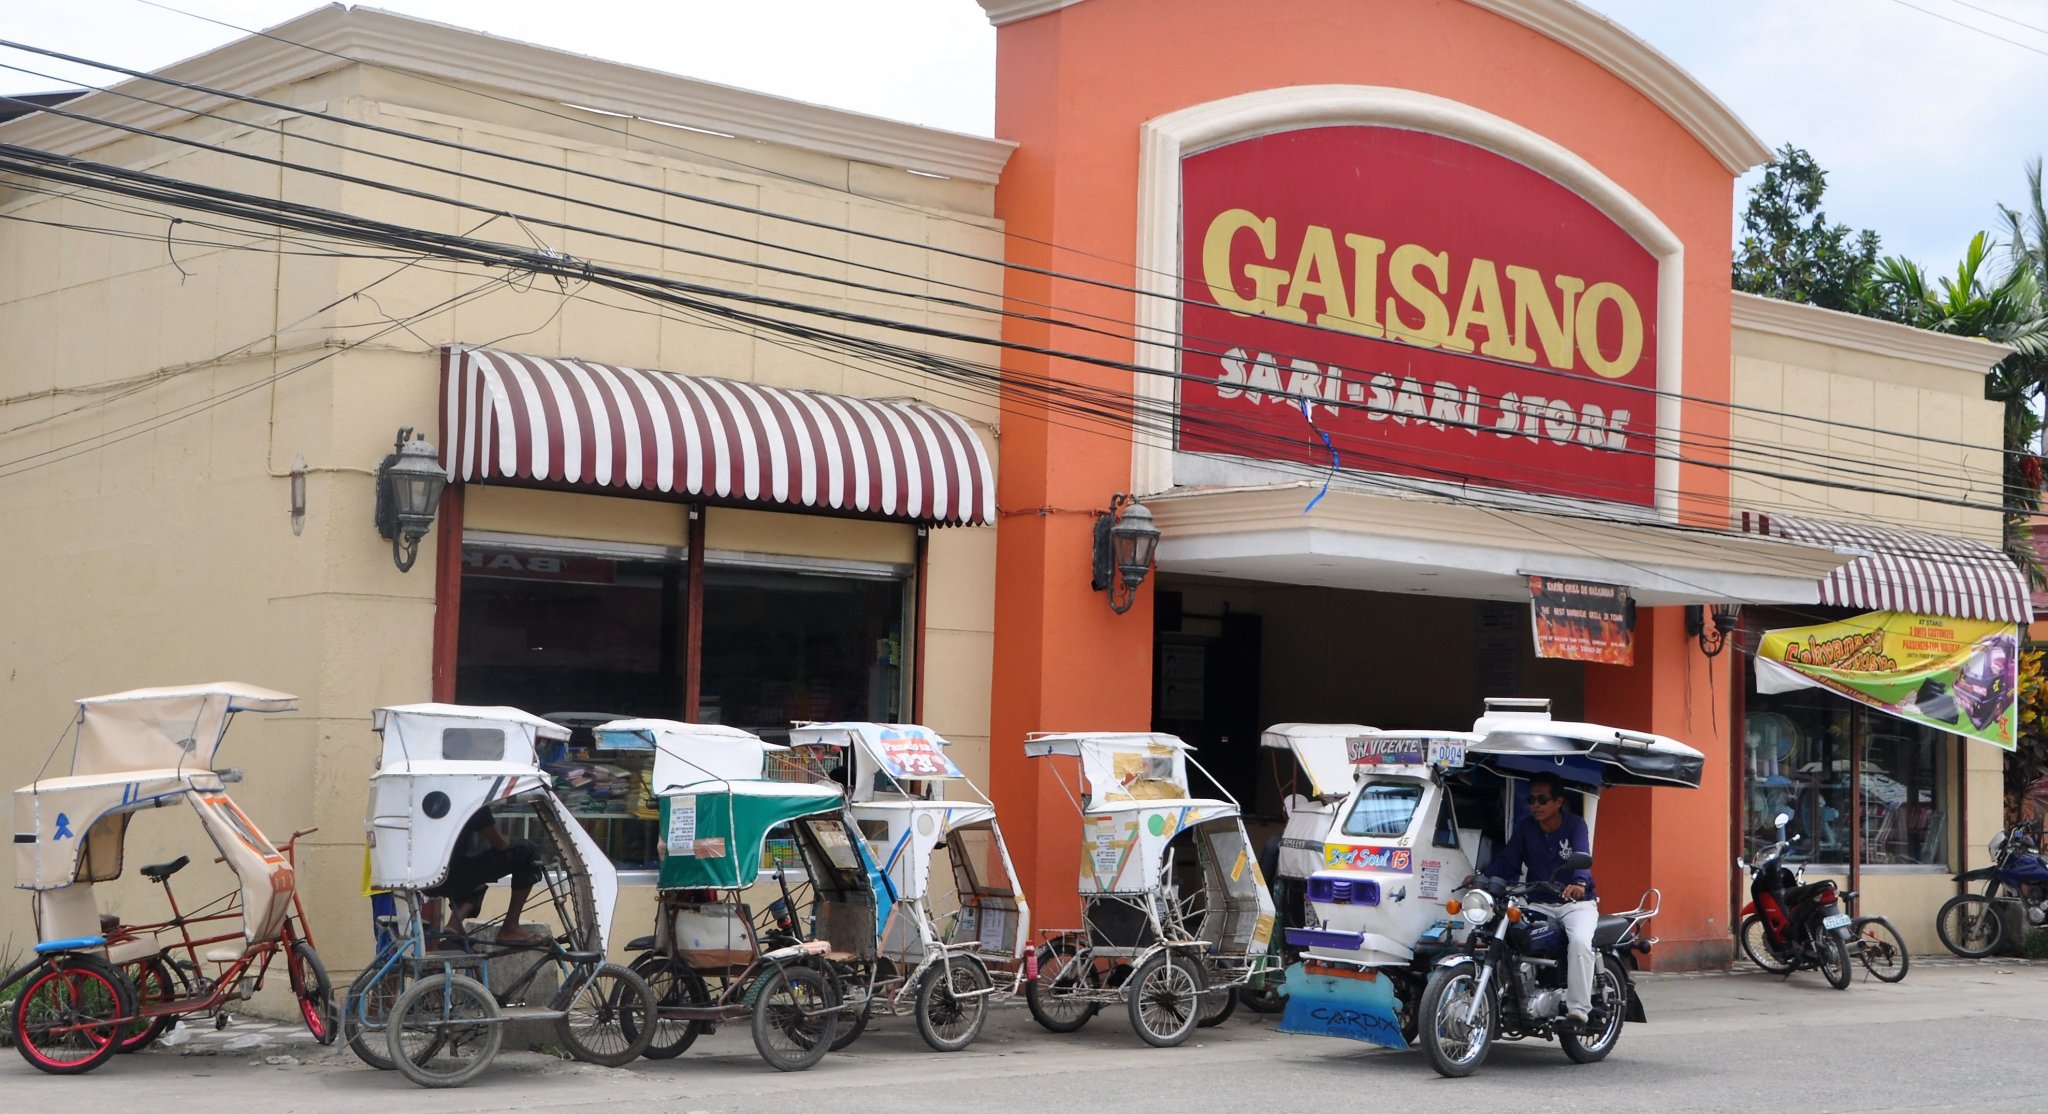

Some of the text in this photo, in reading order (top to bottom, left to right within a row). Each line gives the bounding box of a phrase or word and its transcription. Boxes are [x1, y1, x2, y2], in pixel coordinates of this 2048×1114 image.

[1203, 208, 1643, 378] GAISANO
[1216, 347, 1630, 453] SARI-SARI STORE
[1439, 746, 1462, 761] 0004
